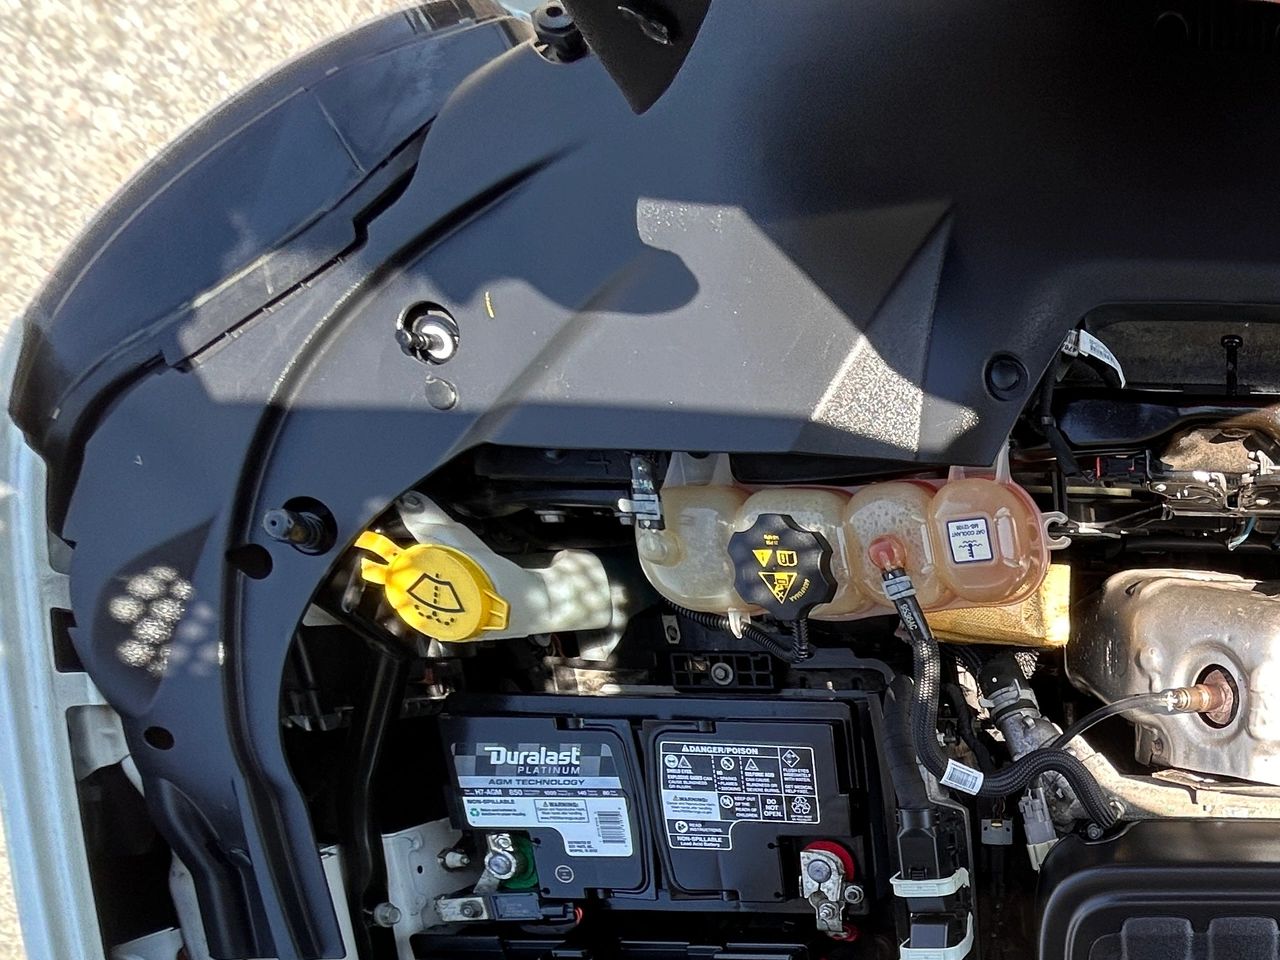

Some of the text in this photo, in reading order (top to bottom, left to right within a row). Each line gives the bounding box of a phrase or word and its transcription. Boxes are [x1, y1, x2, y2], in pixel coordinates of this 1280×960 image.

[690, 745, 758, 755] DANGER/POISON
[484, 746, 581, 765] Duralast
[517, 766, 580, 774] PLATINUM
